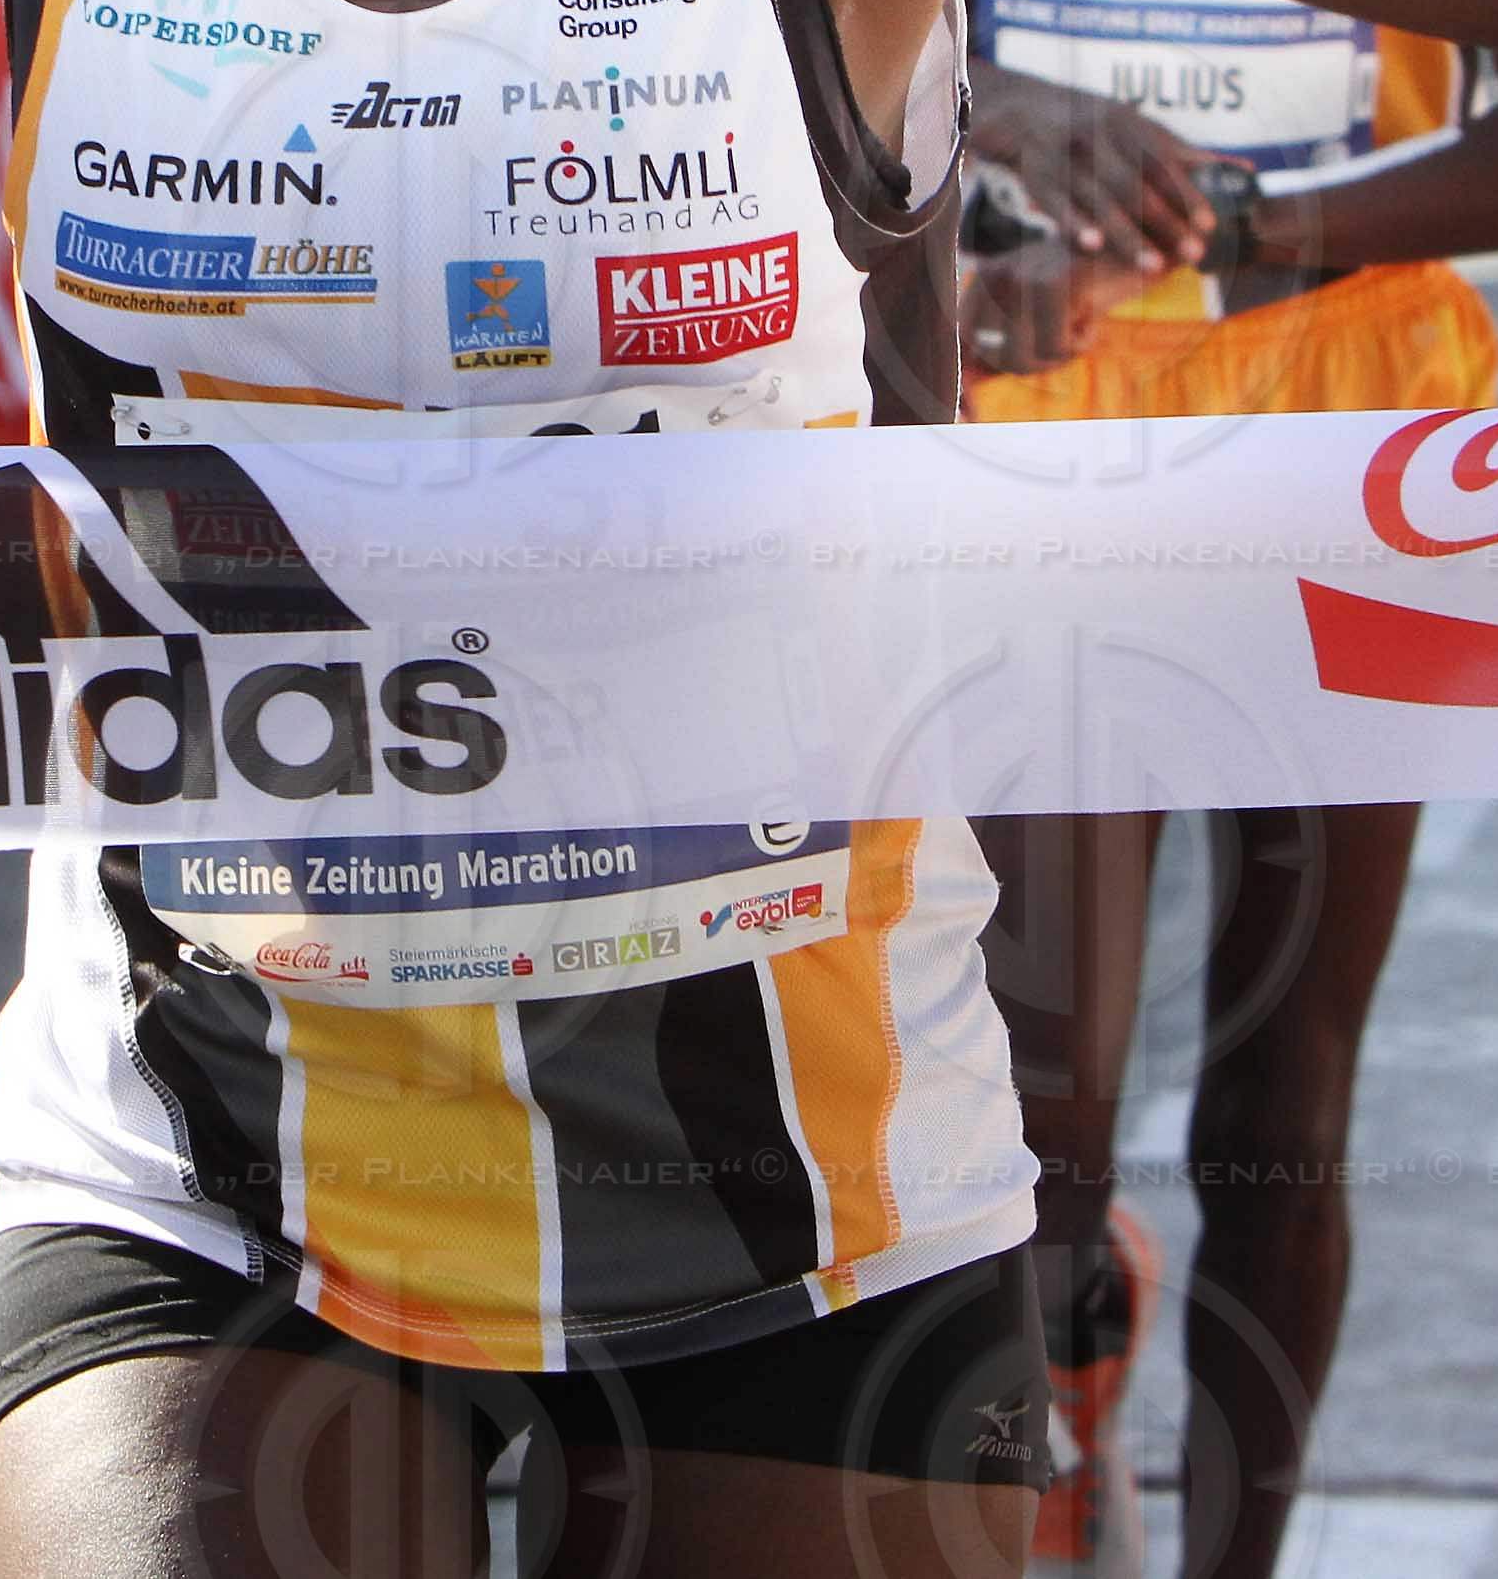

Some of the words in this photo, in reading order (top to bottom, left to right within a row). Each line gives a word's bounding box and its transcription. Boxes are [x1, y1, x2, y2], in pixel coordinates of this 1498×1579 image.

[559, 15, 637, 39] Group
[74, 141, 323, 205] GARMIN
[485, 205, 693, 237] Treuhand
[712, 194, 761, 225] AG
[63, 219, 244, 281] TURRACHER
[256, 238, 374, 275] HÖHE
[57, 276, 237, 314] www.turracherhoehe.at
[611, 246, 791, 316] KLEINE
[613, 308, 789, 358] ZEITUNG
[180, 857, 292, 895] Kleine
[305, 857, 444, 900] Zeitung
[457, 843, 637, 889] Marathon
[391, 960, 510, 984] SPARKASSE
[555, 930, 677, 970] GRAZ
